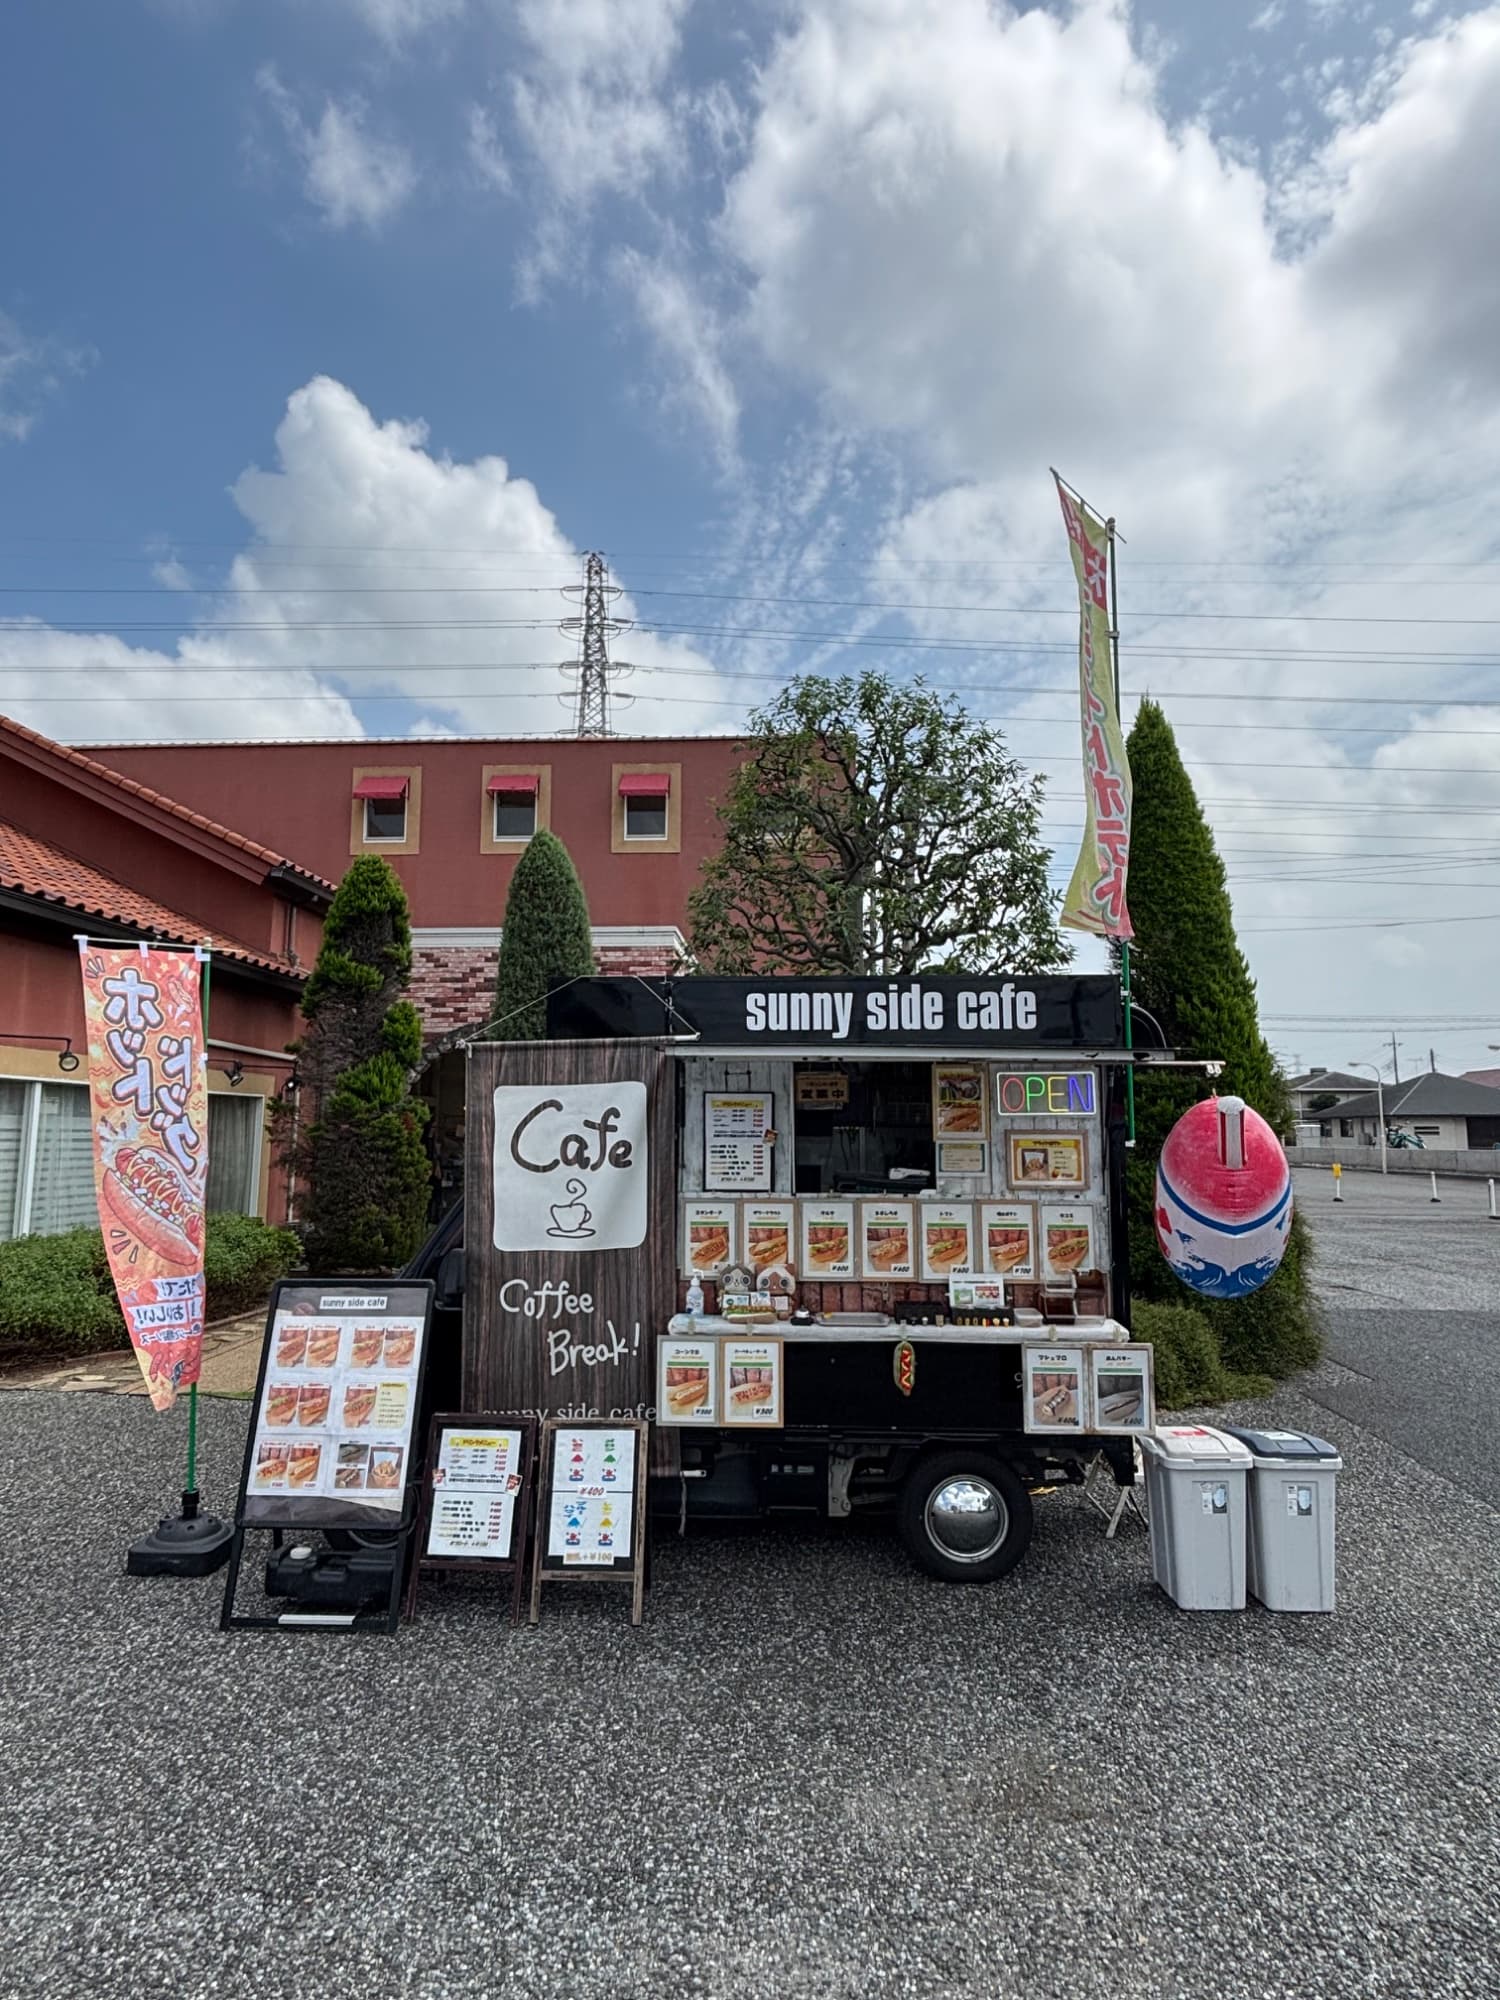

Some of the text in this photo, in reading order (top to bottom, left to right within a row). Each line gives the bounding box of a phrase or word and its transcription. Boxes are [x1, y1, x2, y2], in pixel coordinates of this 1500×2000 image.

[746, 983, 1037, 1039] sunny side cafe
[1002, 1075, 1092, 1112] OPEN
[511, 1099, 633, 1172] Cafe
[322, 1297, 385, 1307] sunny side cafe
[499, 1279, 595, 1320] Coffee
[548, 1319, 641, 1376] Break!
[557, 1402, 600, 1419] side
[609, 1403, 657, 1421] cafe
